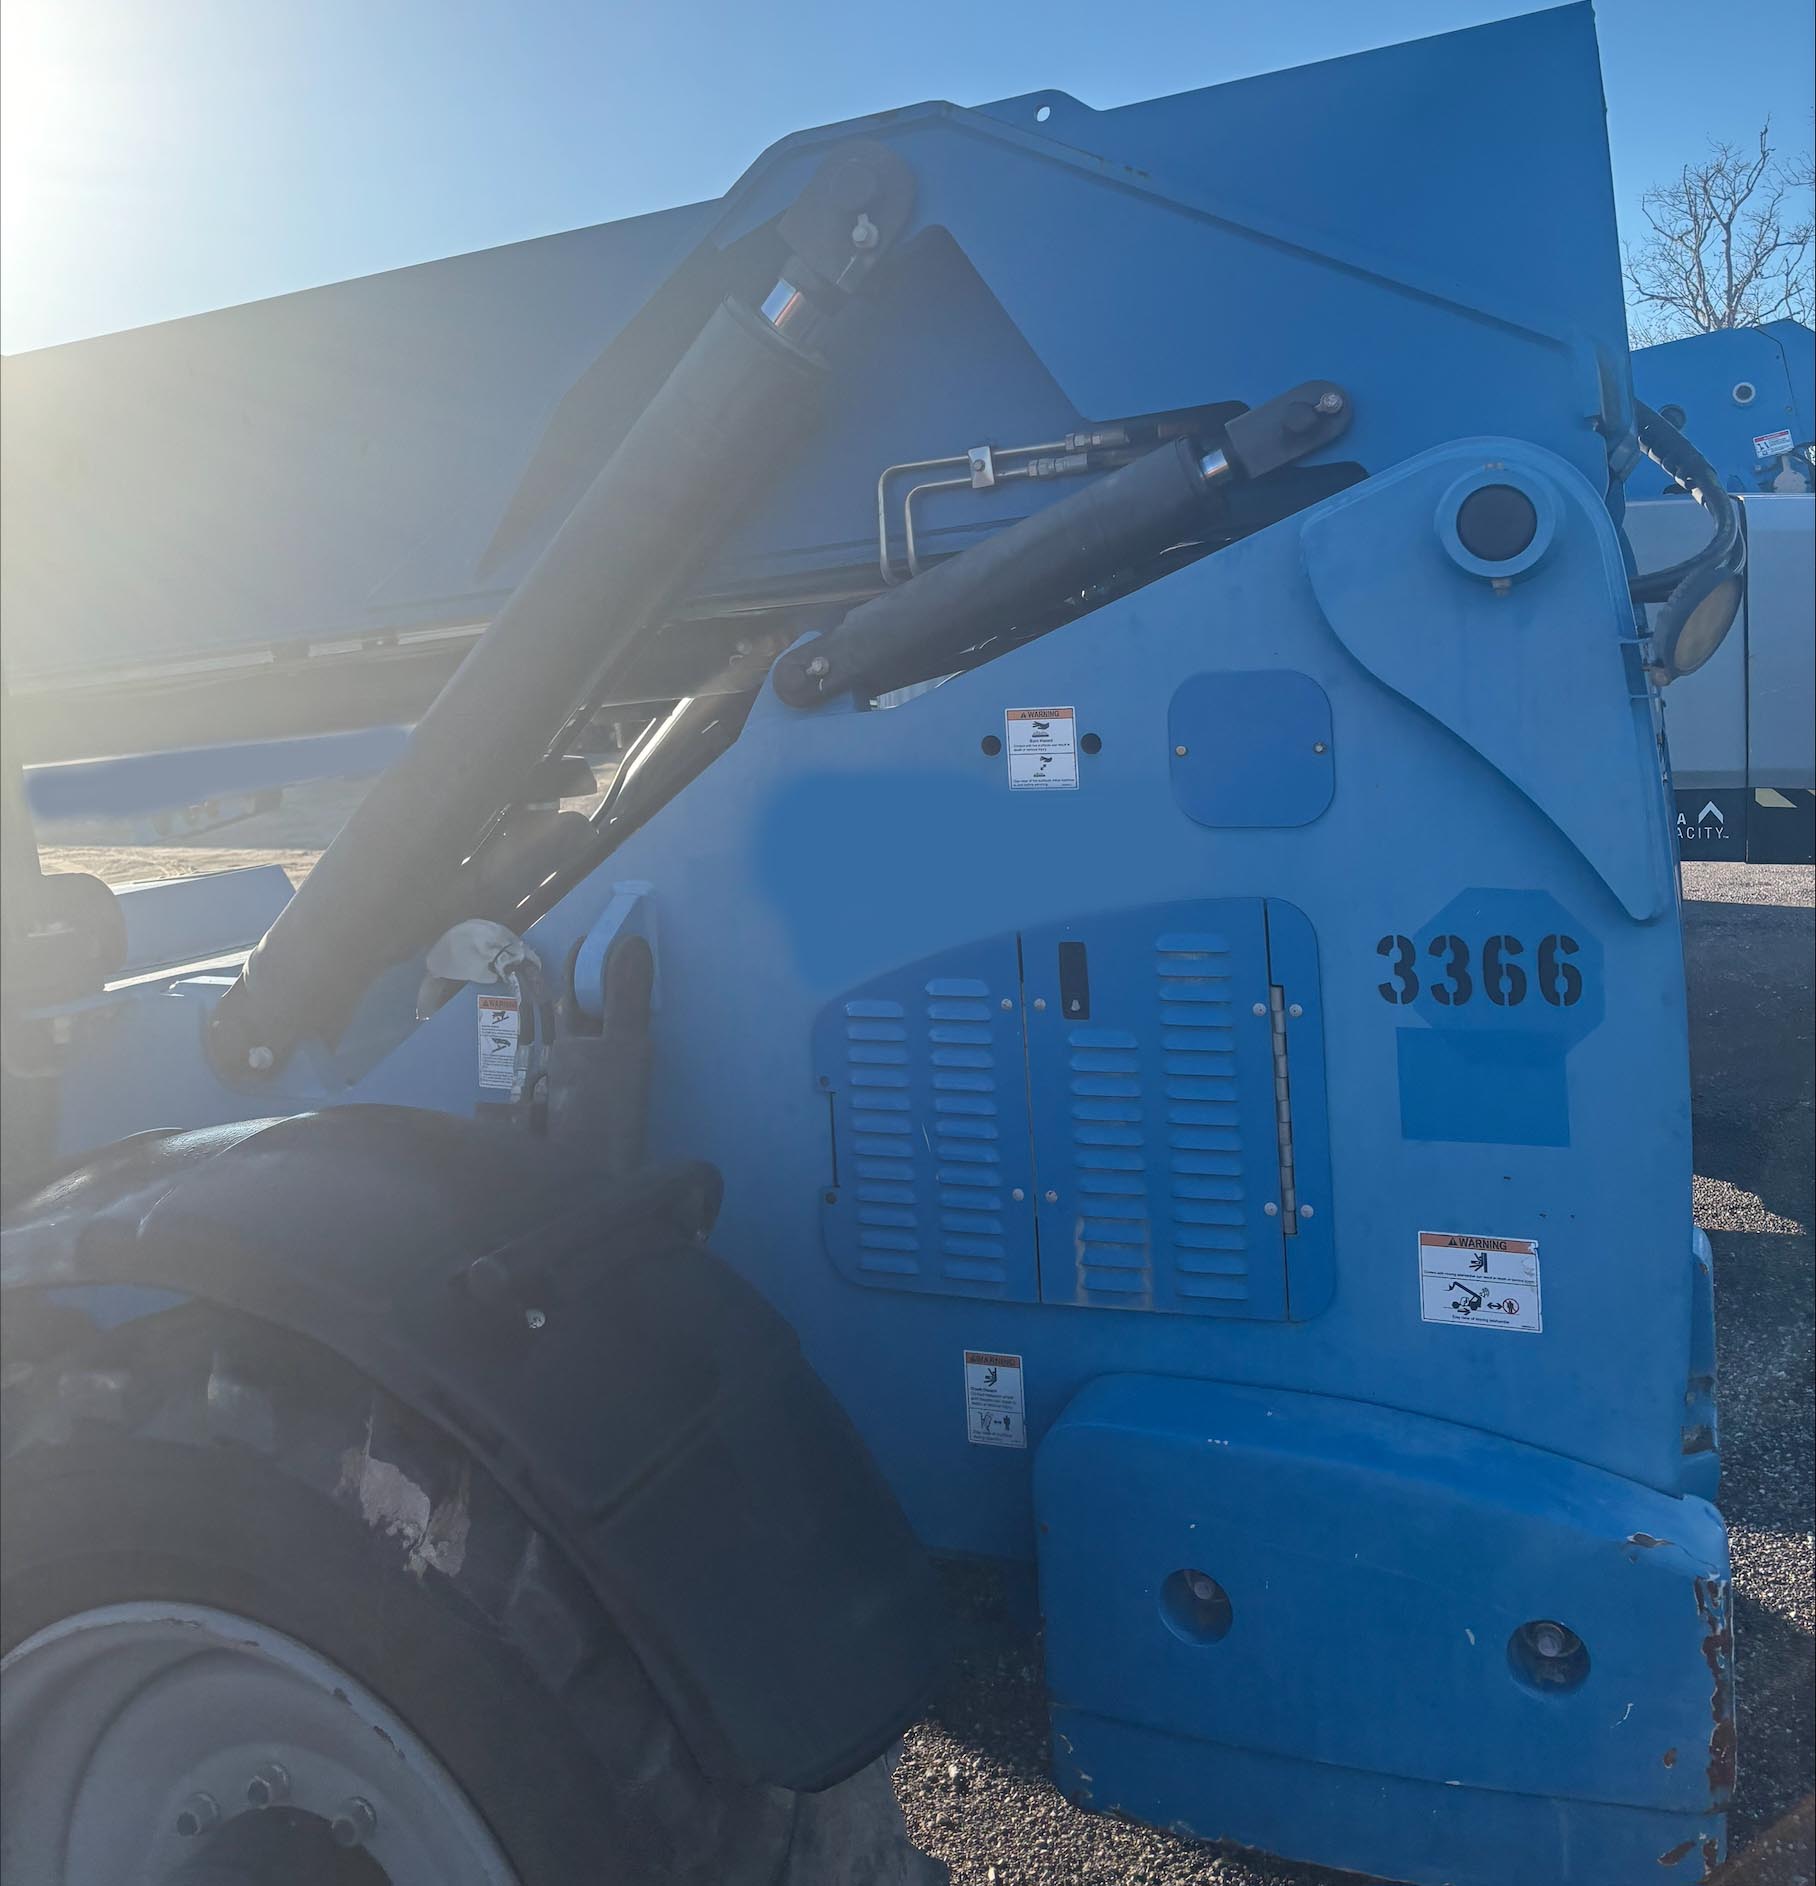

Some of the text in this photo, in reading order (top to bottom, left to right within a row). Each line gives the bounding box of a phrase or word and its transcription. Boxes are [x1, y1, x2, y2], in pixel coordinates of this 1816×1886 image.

[1027, 710, 1060, 718] WARNING
[1376, 934, 1583, 1007] 3366
[1458, 1237, 1508, 1251] WARNING
